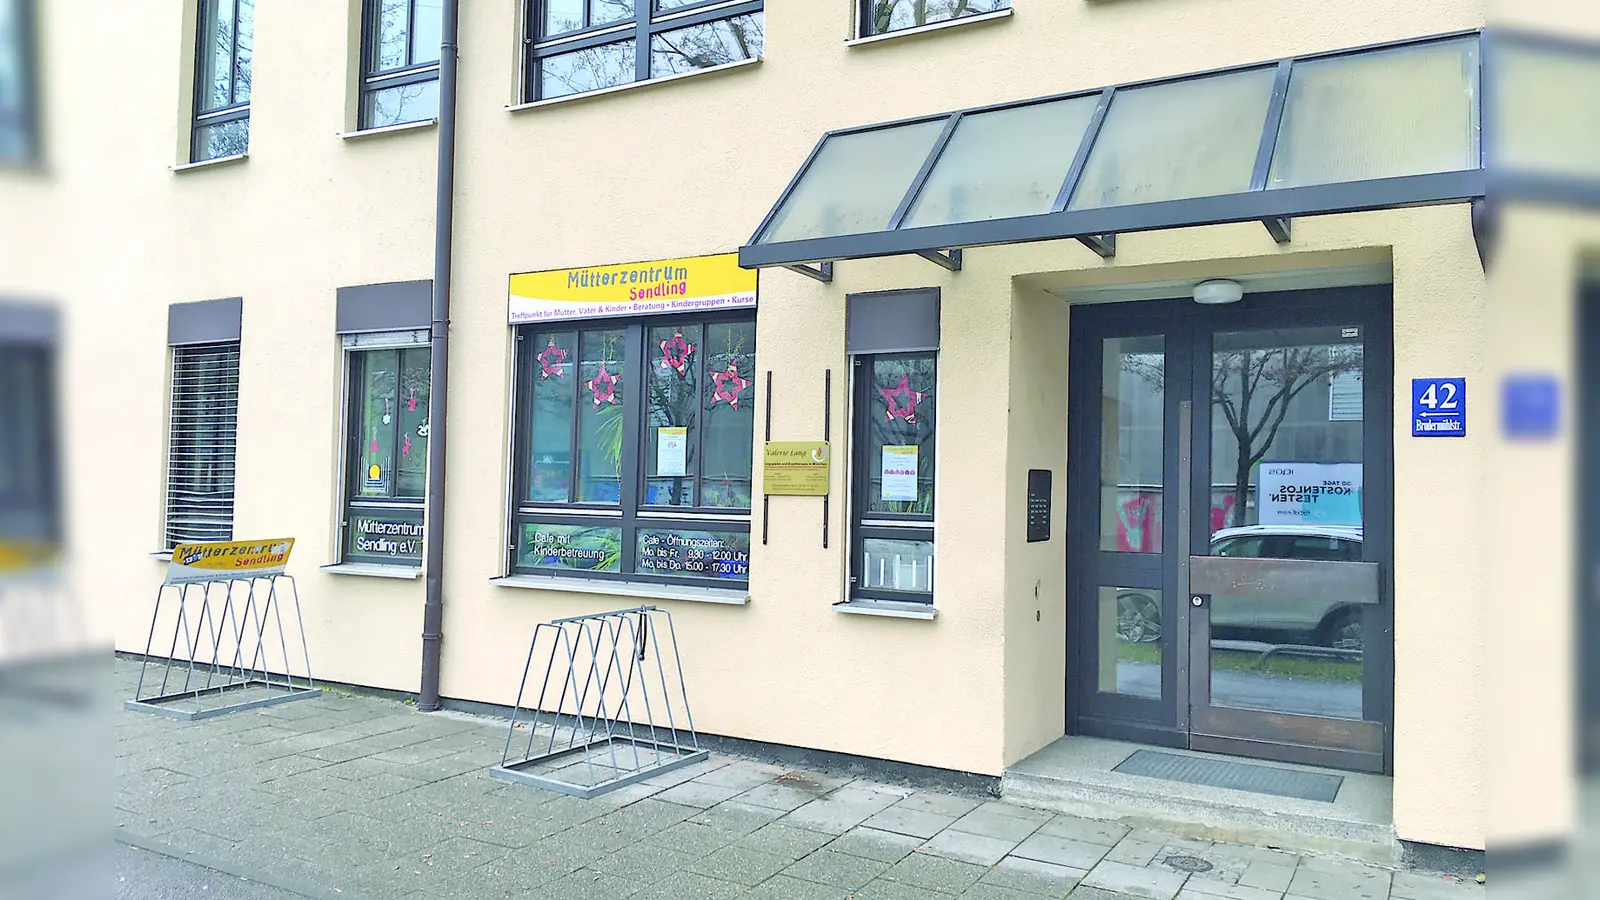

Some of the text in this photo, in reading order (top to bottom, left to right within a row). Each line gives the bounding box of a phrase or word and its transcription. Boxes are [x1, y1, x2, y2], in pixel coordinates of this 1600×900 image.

[567, 266, 688, 289] Mütterzentrum
[629, 280, 687, 301] Sendling
[511, 310, 542, 320] Treffpunkt
[597, 305, 603, 313] &
[605, 304, 627, 313] Kinder
[633, 302, 665, 311] Beratung
[671, 298, 725, 308] Kindergruppen
[731, 295, 754, 304] Kurse
[1419, 382, 1458, 409] 42
[357, 519, 424, 536] Mütterzentrum
[356, 536, 417, 556] Sendling e.V.
[557, 533, 571, 544] mit
[235, 553, 284, 567] Sendling
[534, 544, 606, 562] Kinderbetreuung
[657, 548, 668, 557] bis
[669, 549, 680, 558] Fr.
[688, 549, 704, 559] 9.30
[711, 550, 732, 560] 12.00
[733, 551, 748, 562] Uhr
[656, 560, 668, 569] bis
[669, 560, 681, 570] Do.
[685, 561, 704, 572] 15.00
[712, 562, 731, 573] 17.30
[733, 563, 748, 574] Uhr
